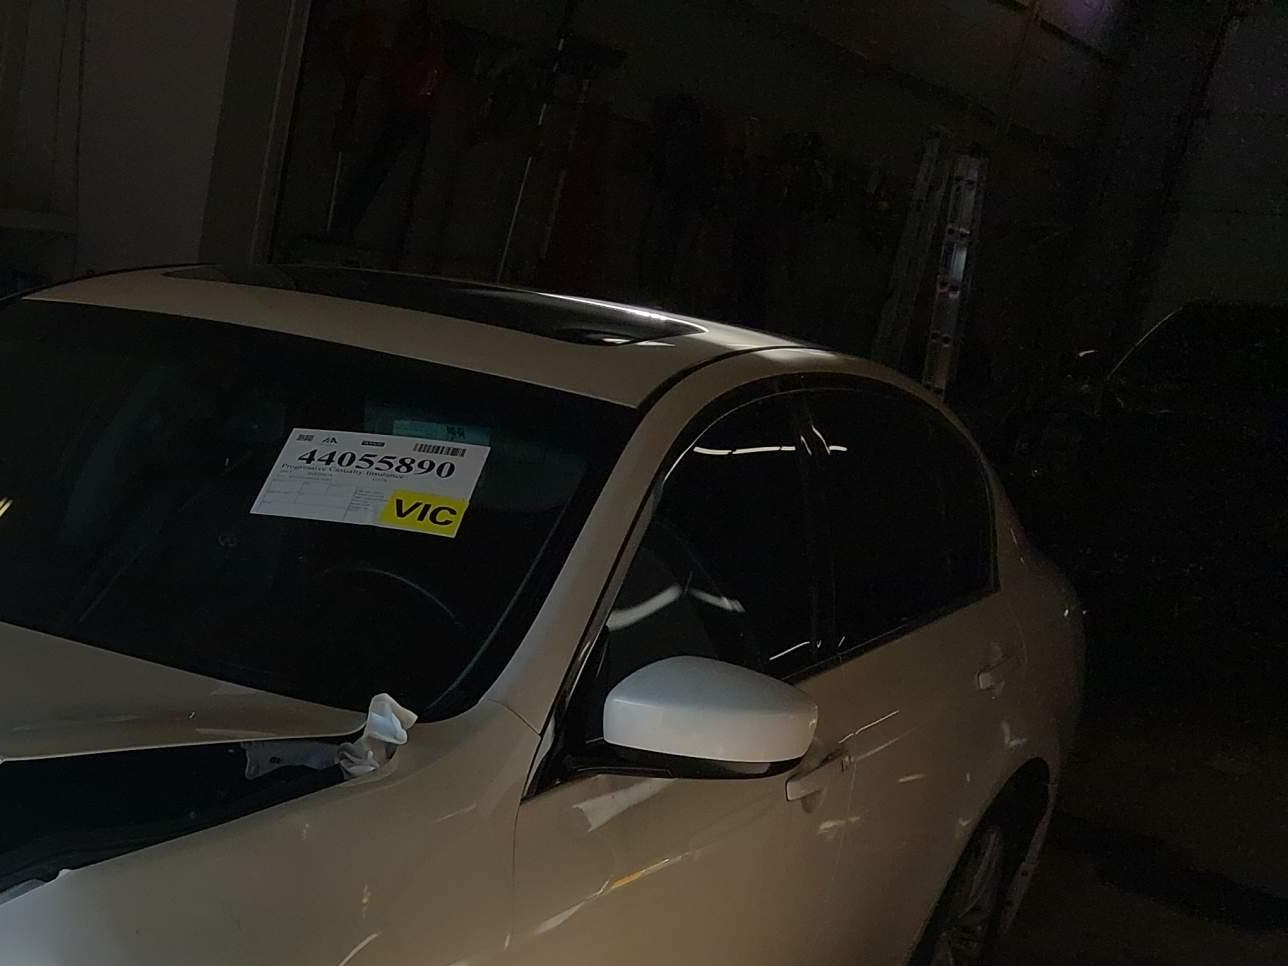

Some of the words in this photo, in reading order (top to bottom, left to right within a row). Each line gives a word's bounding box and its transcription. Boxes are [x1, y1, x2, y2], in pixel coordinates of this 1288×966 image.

[298, 449, 455, 479] 44055890
[328, 467, 363, 476] Casualty
[395, 498, 457, 526] VIC
